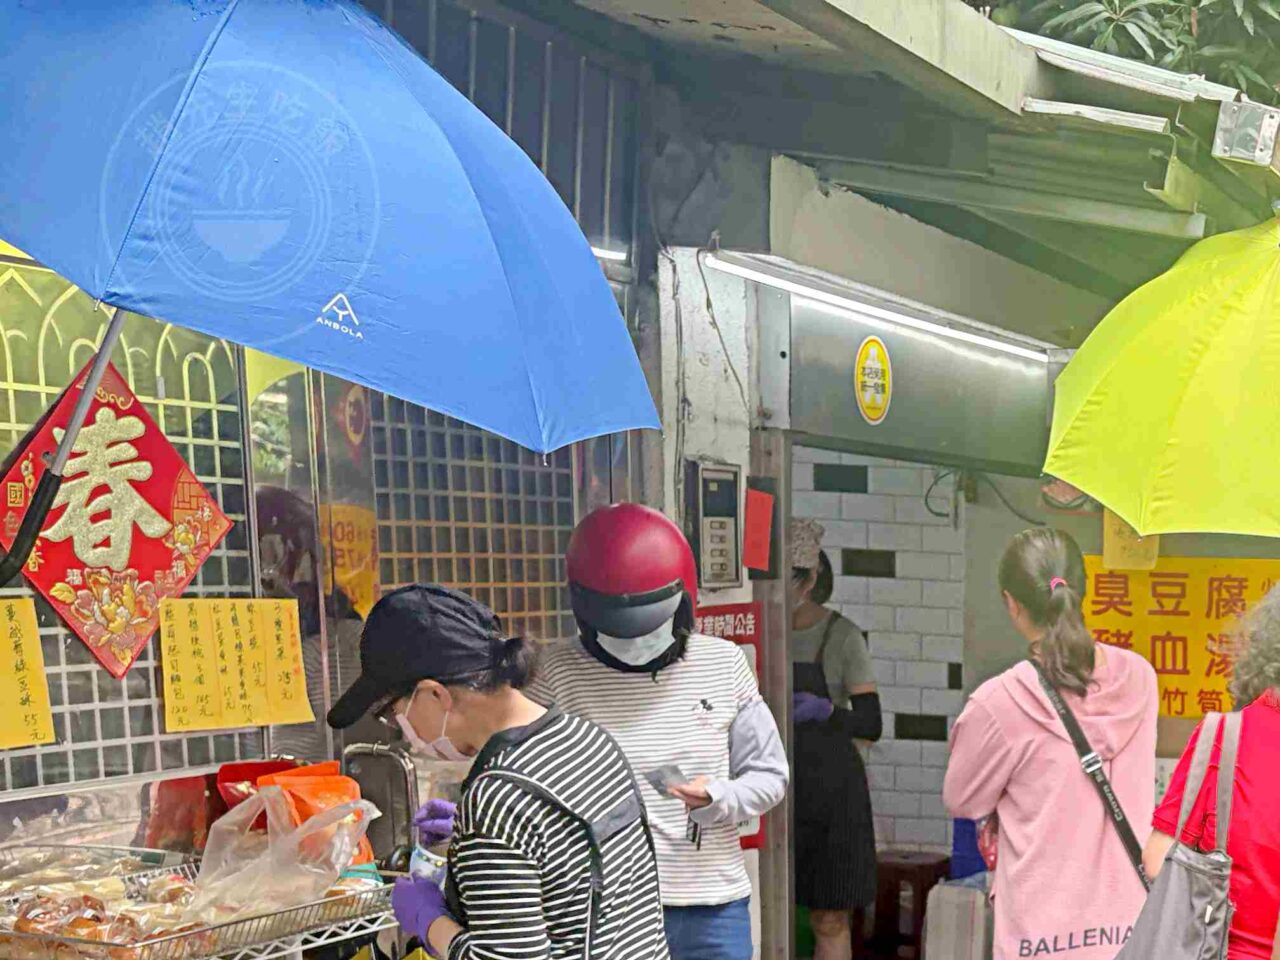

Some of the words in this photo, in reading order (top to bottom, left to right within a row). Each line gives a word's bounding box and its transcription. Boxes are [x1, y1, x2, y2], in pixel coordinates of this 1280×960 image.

[40, 407, 173, 571] 春
[1091, 570, 1248, 619] 臭豆腐
